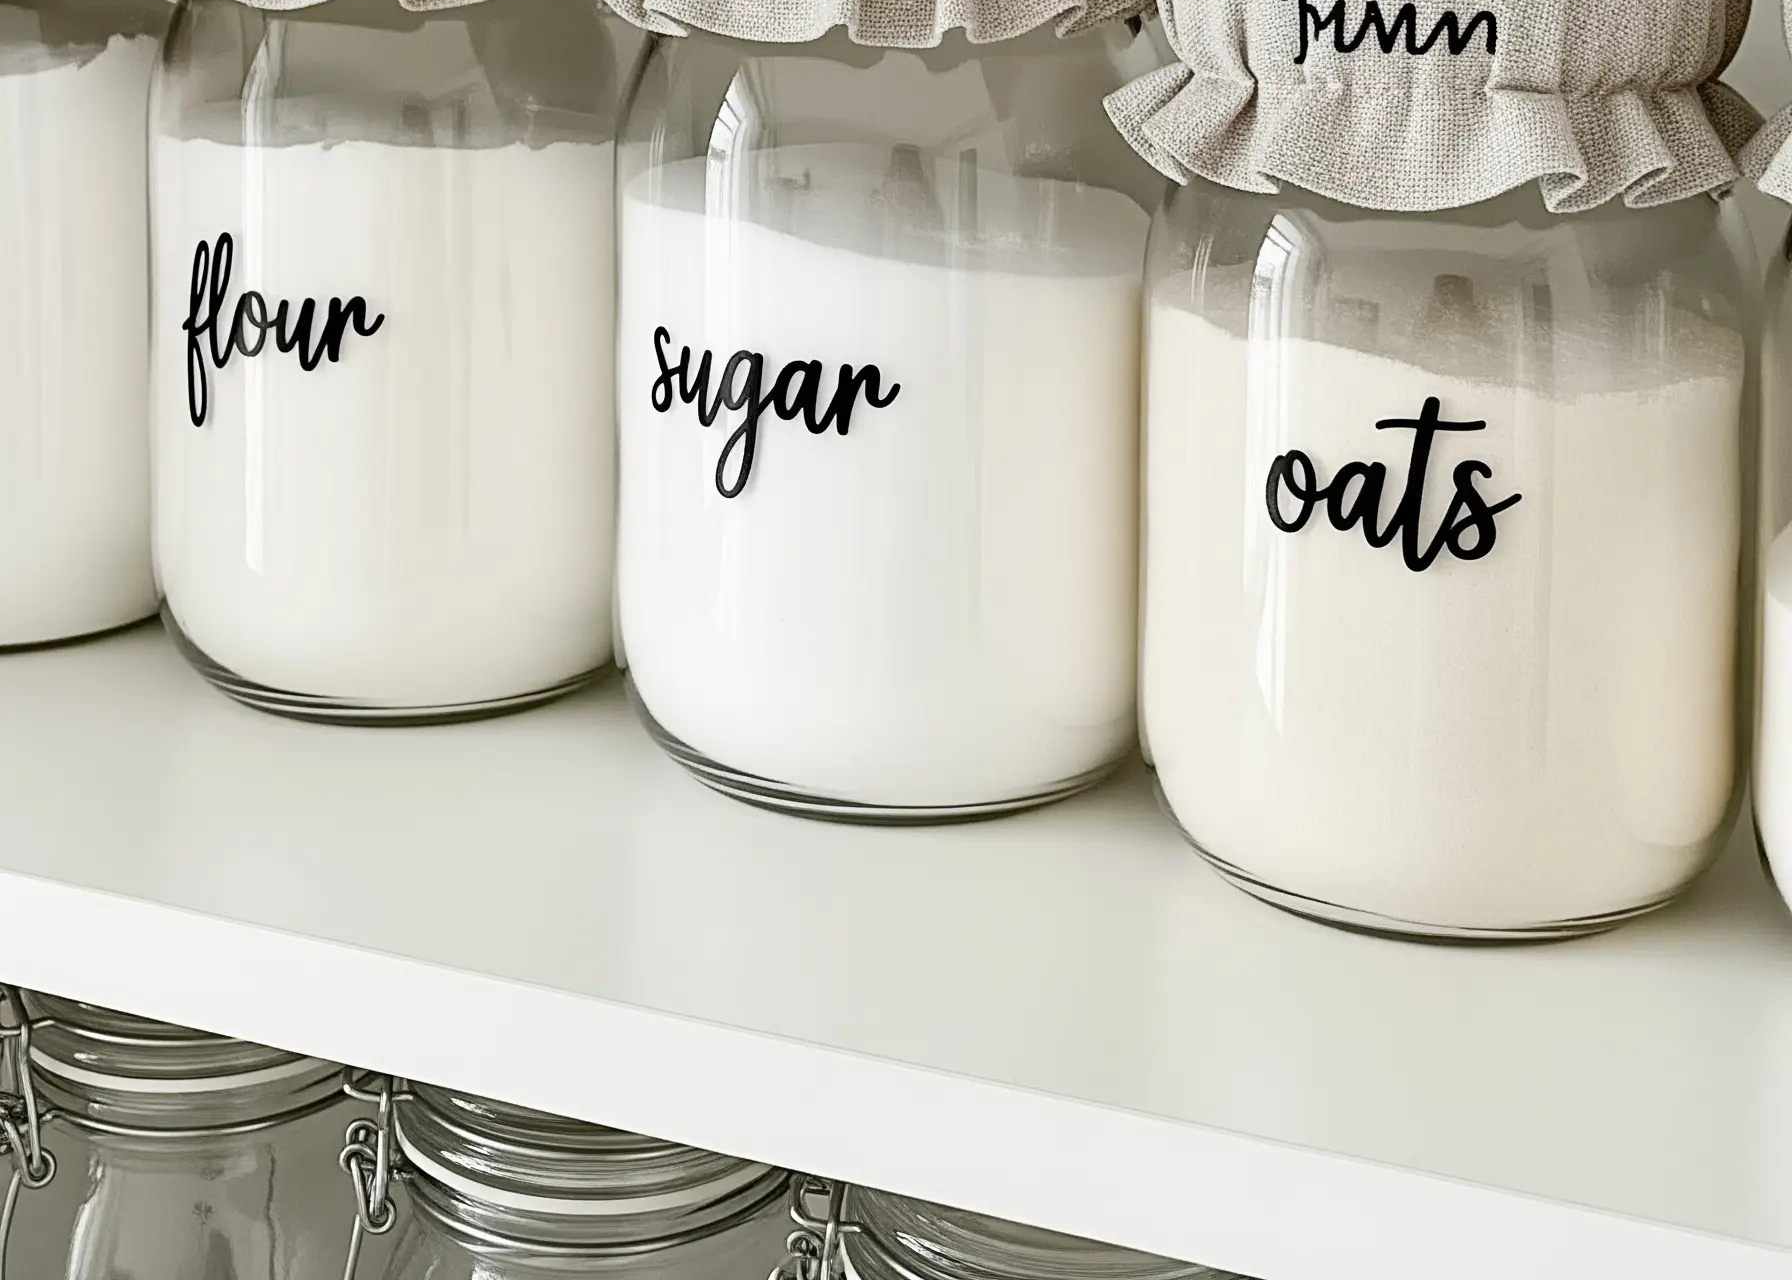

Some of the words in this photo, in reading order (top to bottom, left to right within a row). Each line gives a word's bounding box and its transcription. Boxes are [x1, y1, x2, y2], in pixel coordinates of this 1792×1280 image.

[182, 232, 385, 428] flour
[651, 326, 901, 499] sugar
[1265, 396, 1523, 573] oats
